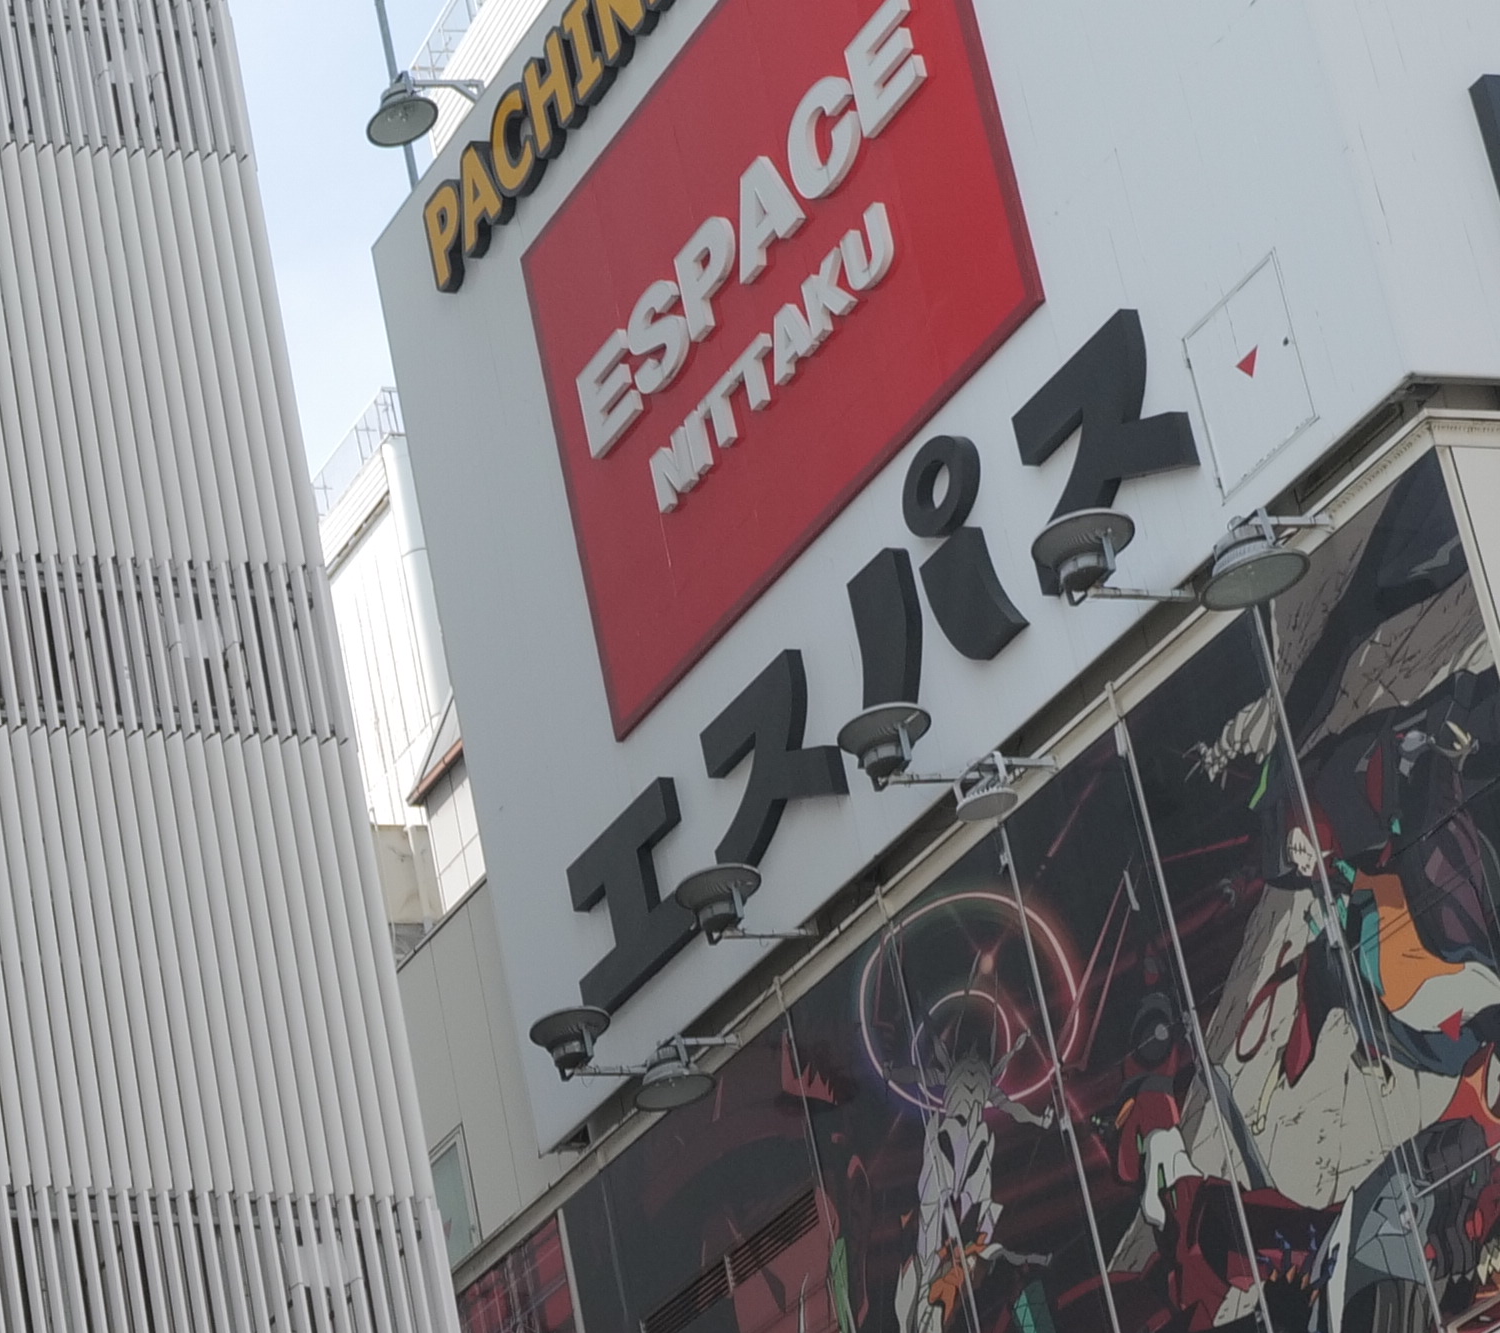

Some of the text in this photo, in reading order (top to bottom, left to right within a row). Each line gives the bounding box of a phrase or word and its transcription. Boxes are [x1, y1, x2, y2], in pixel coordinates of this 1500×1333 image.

[575, 18, 929, 460] ESPACE
[648, 201, 896, 518] NITTAKU
[565, 306, 1202, 1014] エスパス
